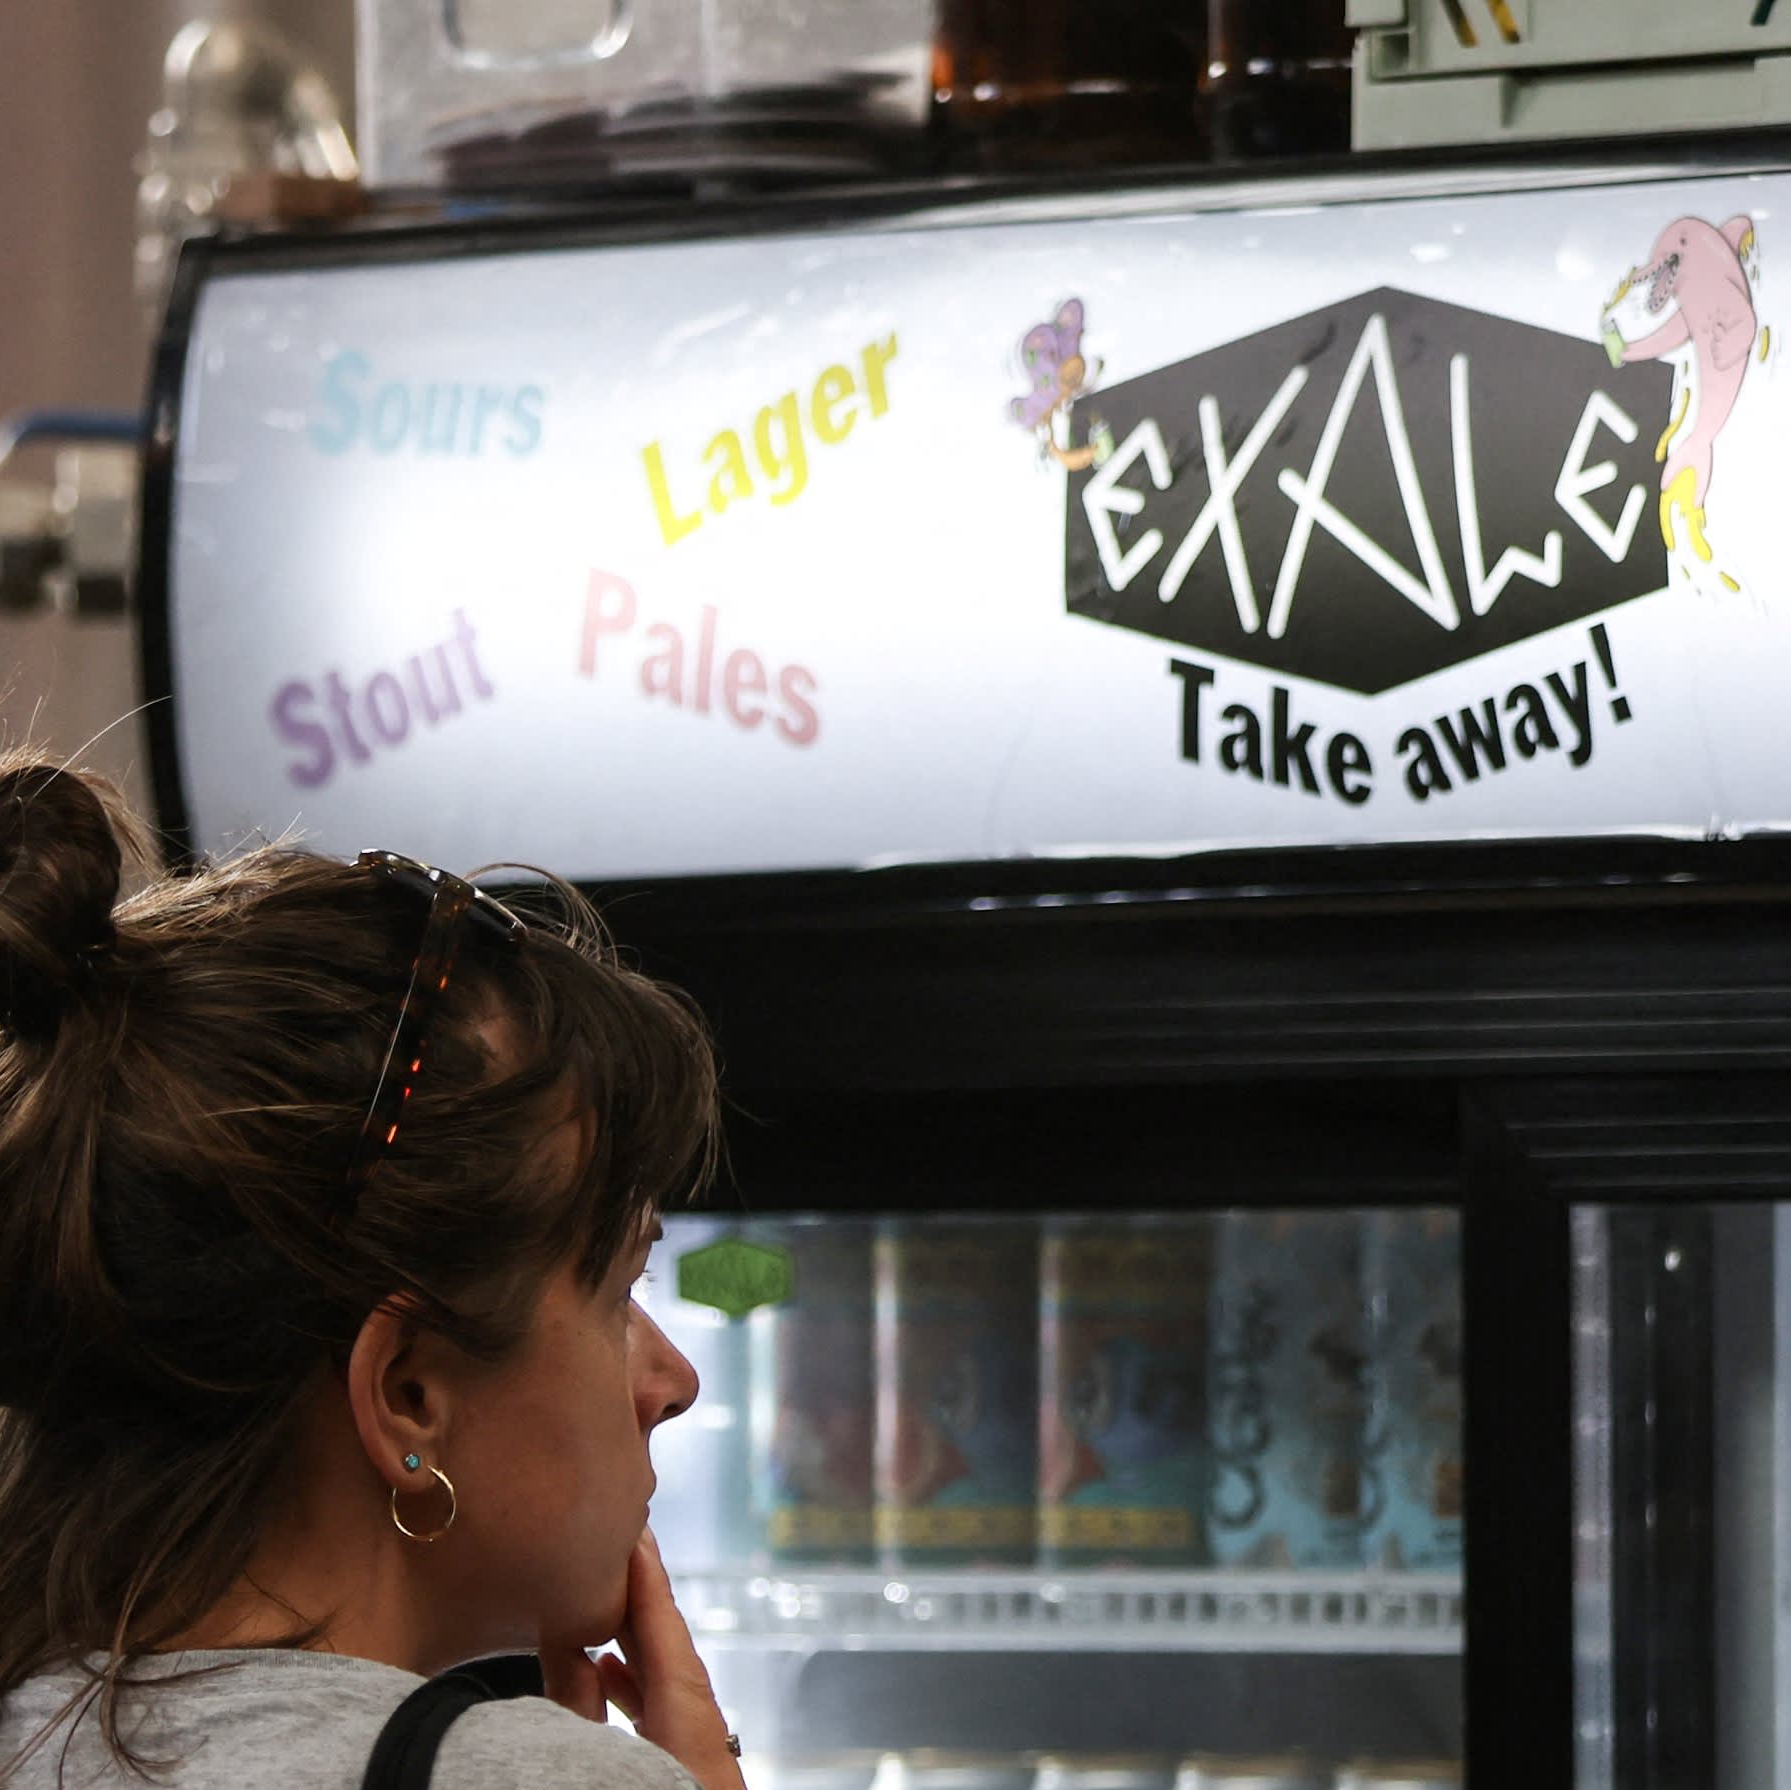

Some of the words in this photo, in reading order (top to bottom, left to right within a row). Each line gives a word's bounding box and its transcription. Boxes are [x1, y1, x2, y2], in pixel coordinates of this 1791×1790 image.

[312, 350, 546, 457] Sours
[641, 330, 899, 546] Lager
[1082, 312, 1647, 640] EXALE
[270, 606, 496, 790] Stout
[577, 567, 823, 748] Pales
[1168, 657, 1375, 805] Take
[1394, 622, 1634, 803] away!
